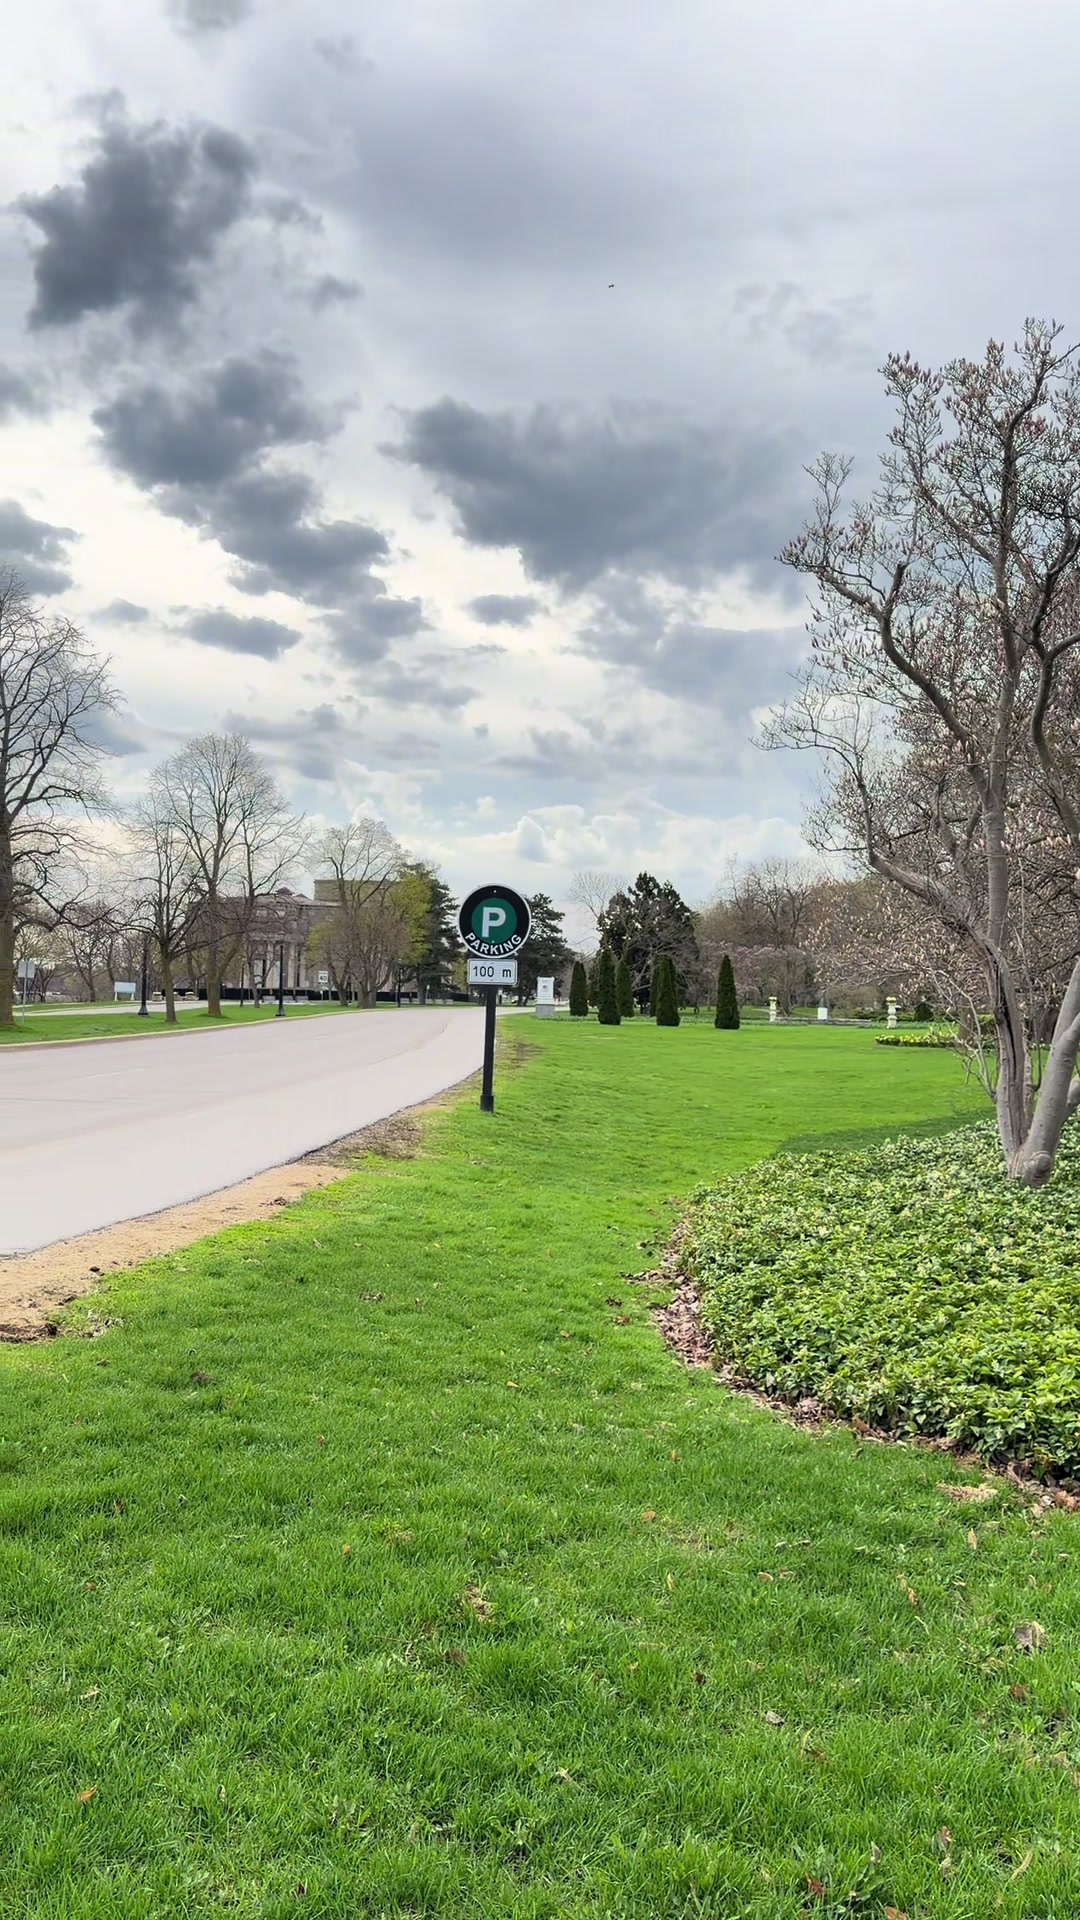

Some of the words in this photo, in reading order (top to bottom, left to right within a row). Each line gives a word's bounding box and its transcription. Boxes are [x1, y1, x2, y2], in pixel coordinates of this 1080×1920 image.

[482, 907, 506, 937] P
[465, 932, 522, 955] PARKING
[473, 966, 494, 977] 100
[502, 969, 511, 977] m
